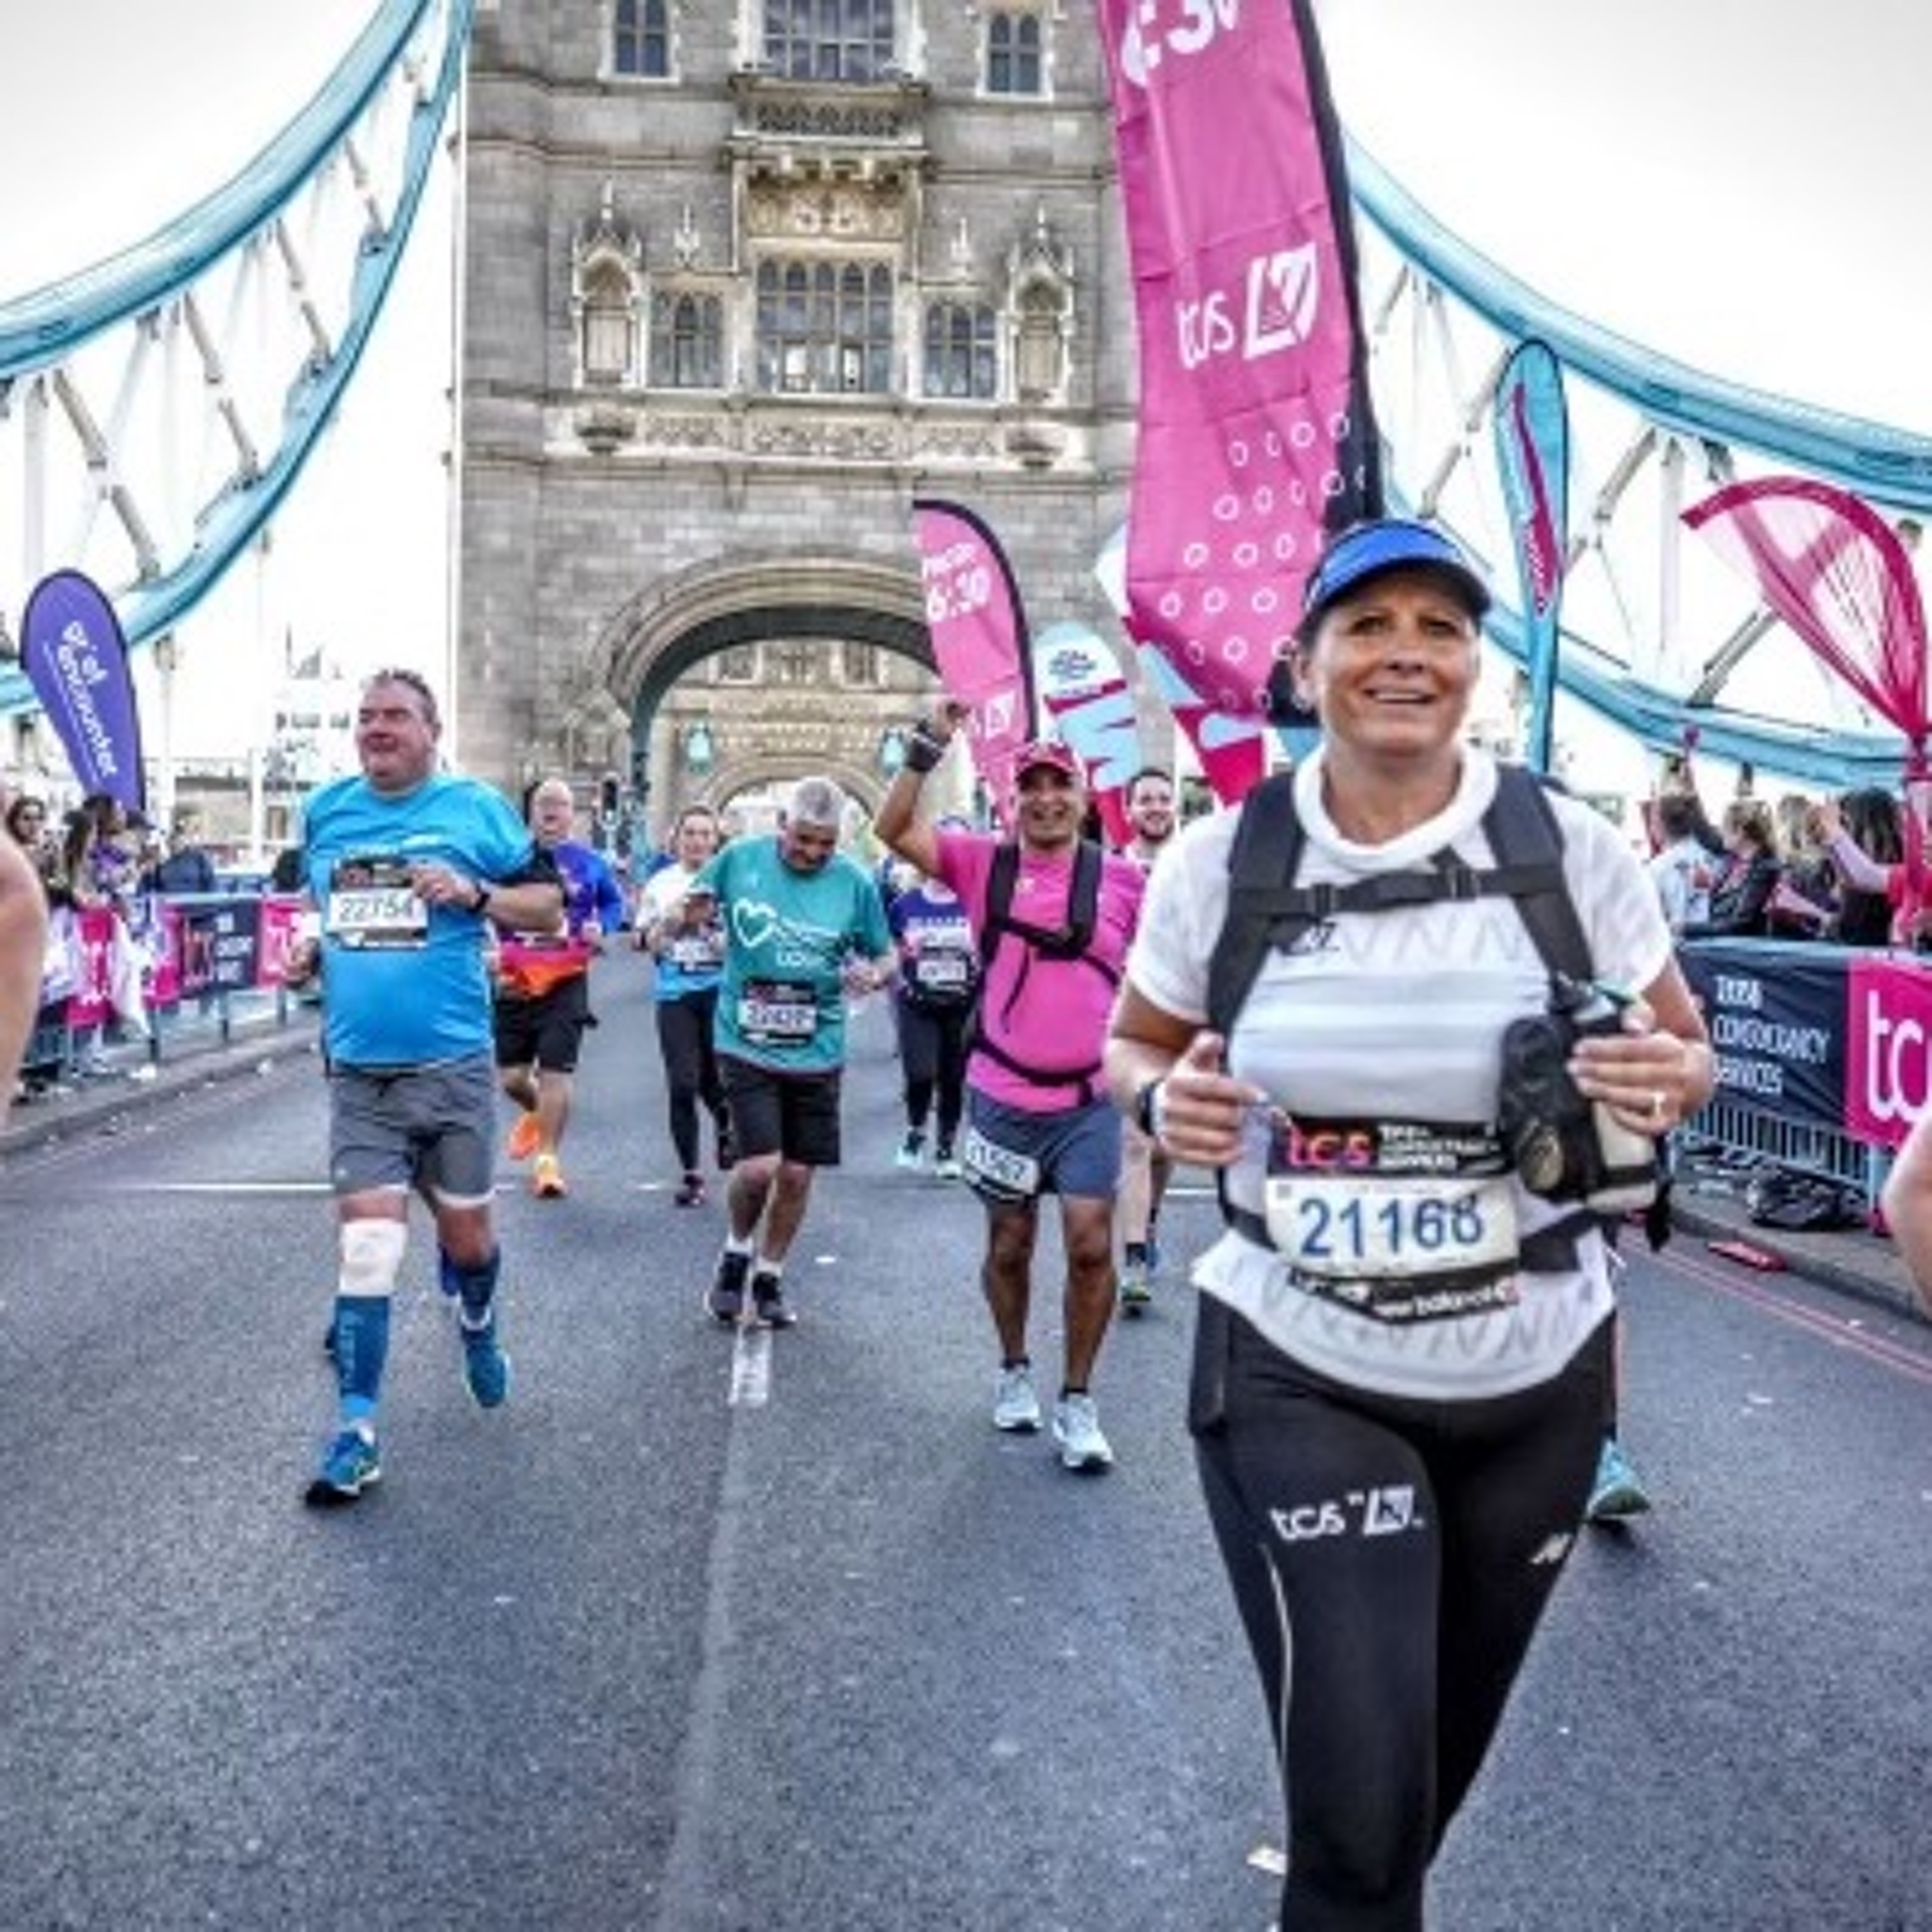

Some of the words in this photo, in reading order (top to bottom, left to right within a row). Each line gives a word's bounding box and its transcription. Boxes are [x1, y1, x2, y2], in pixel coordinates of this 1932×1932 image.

[927, 566, 992, 623] 6:30
[1288, 1124, 1371, 1167] tcs
[1269, 1502, 1345, 1542] tcs
